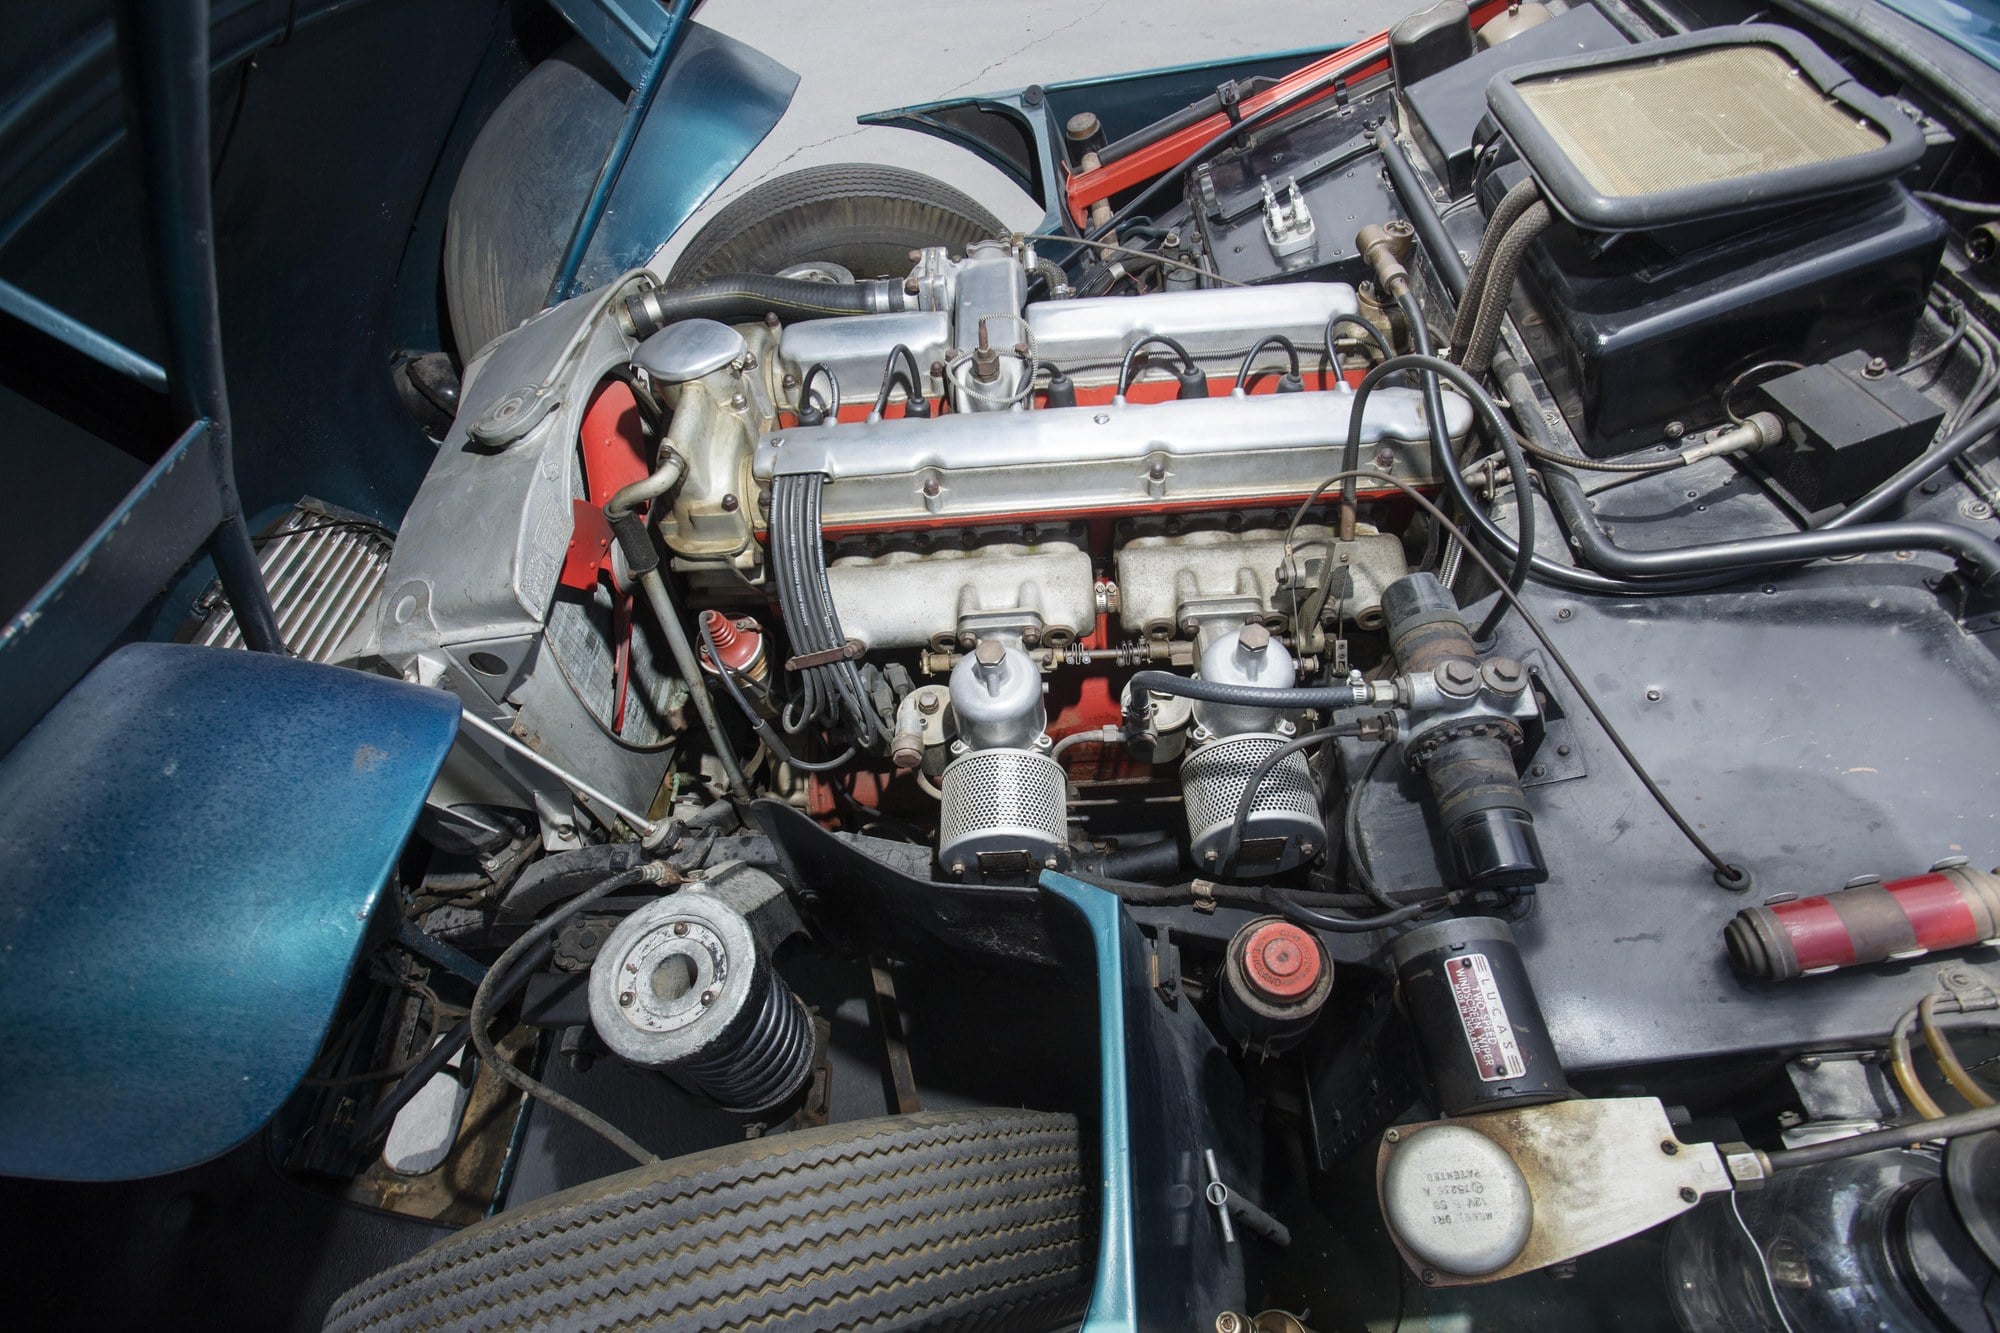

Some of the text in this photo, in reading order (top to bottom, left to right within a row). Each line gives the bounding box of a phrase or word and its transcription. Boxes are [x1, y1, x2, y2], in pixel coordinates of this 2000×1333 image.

[1454, 983, 1480, 1053] MADE IN ENGLAND
[1455, 967, 1495, 1066] WINDSCREEN WIPER
[1472, 986, 1497, 1045] TWO SPEED
[1481, 979, 1513, 1049] LUCAS
